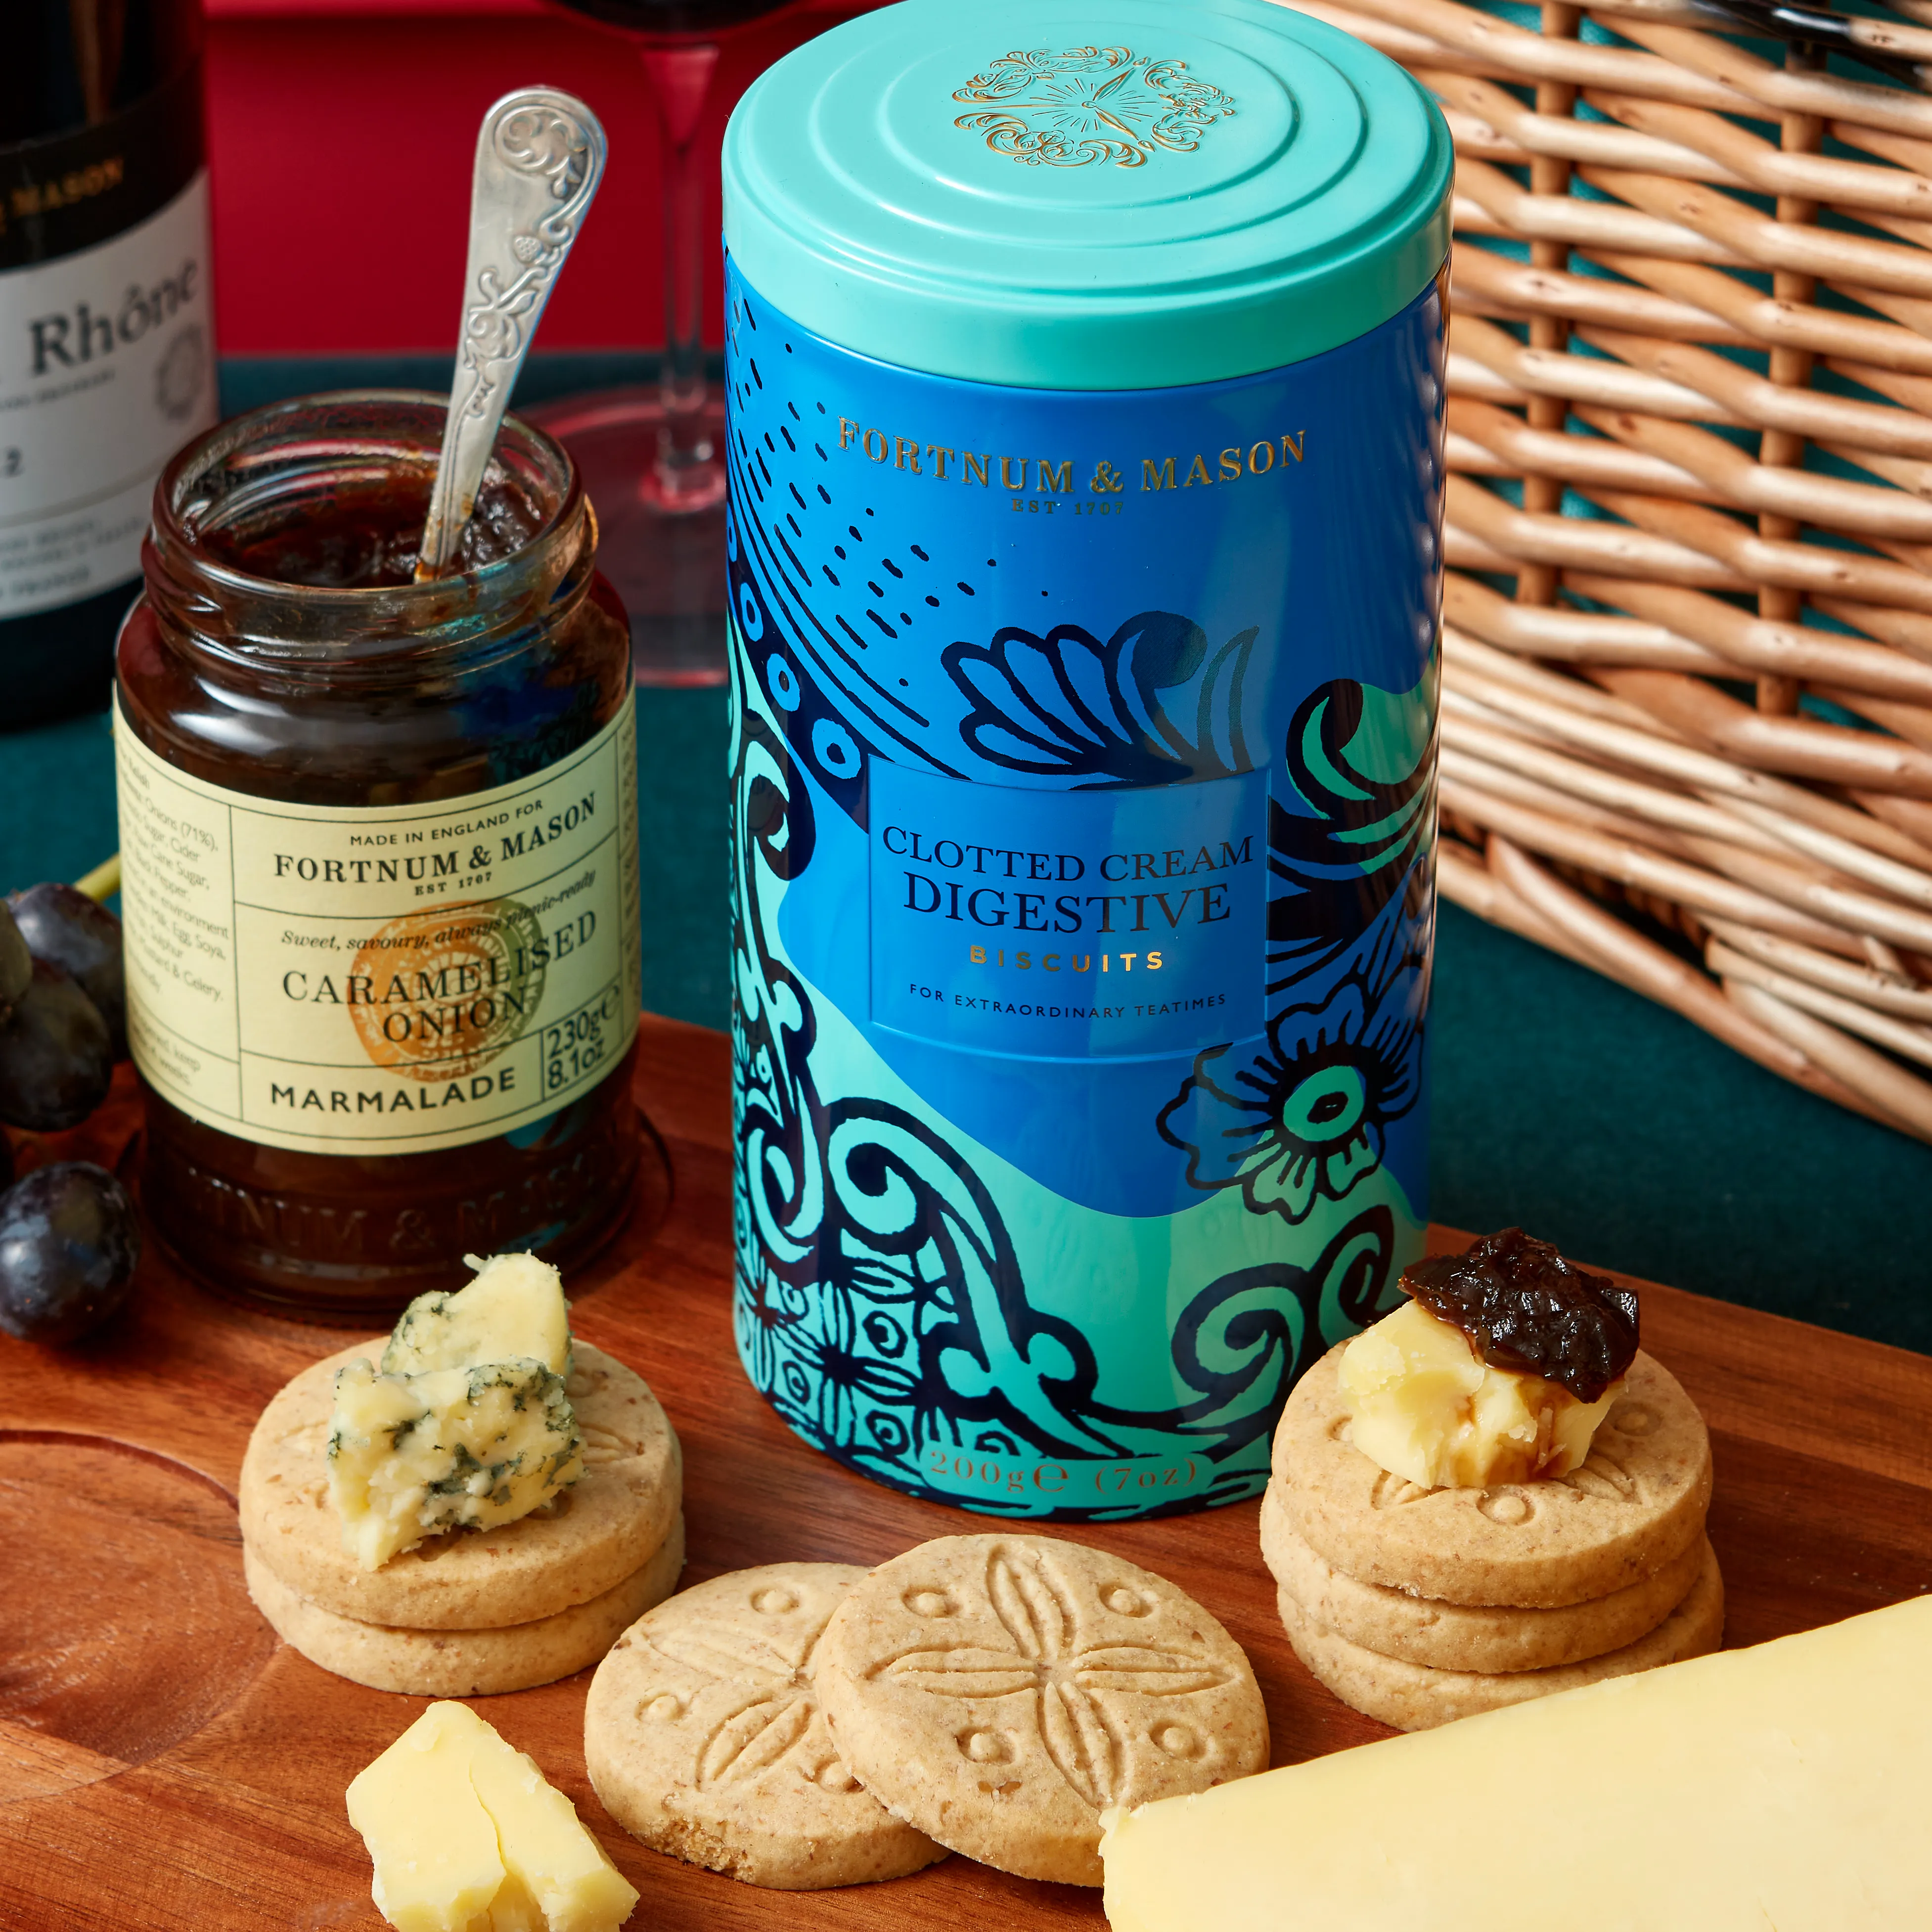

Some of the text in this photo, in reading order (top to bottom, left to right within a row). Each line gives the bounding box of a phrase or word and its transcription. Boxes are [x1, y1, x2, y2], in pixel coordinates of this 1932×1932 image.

[28, 259, 196, 376] Rhône
[837, 416, 1306, 493] FORTNUM & MASON
[1012, 499, 1124, 516] EST 1707
[145, 797, 178, 831] Onions
[351, 799, 544, 846] MADE IN ENGLAND FOR
[171, 837, 201, 862] Cider
[273, 792, 596, 883] FORTNUM & MASON
[883, 826, 1255, 882] CLOTTED CREAM
[177, 860, 210, 891] Sugar,
[415, 872, 492, 896] EST 1707
[161, 897, 229, 941] environment
[281, 869, 596, 951] Sweet, savoury, always picnic-ready
[903, 871, 1230, 934] DIGESTIVE
[283, 910, 595, 1005] CARAMELISED
[970, 945, 1163, 973] BISCUITS
[383, 987, 528, 1042] ONION
[910, 984, 1227, 1019] FOR EXTRAORDINARY TEATIMES
[548, 1038, 606, 1090] 8.1oz
[270, 1067, 515, 1113] MARMALADE
[1094, 1457, 1197, 1494] (7oz)
